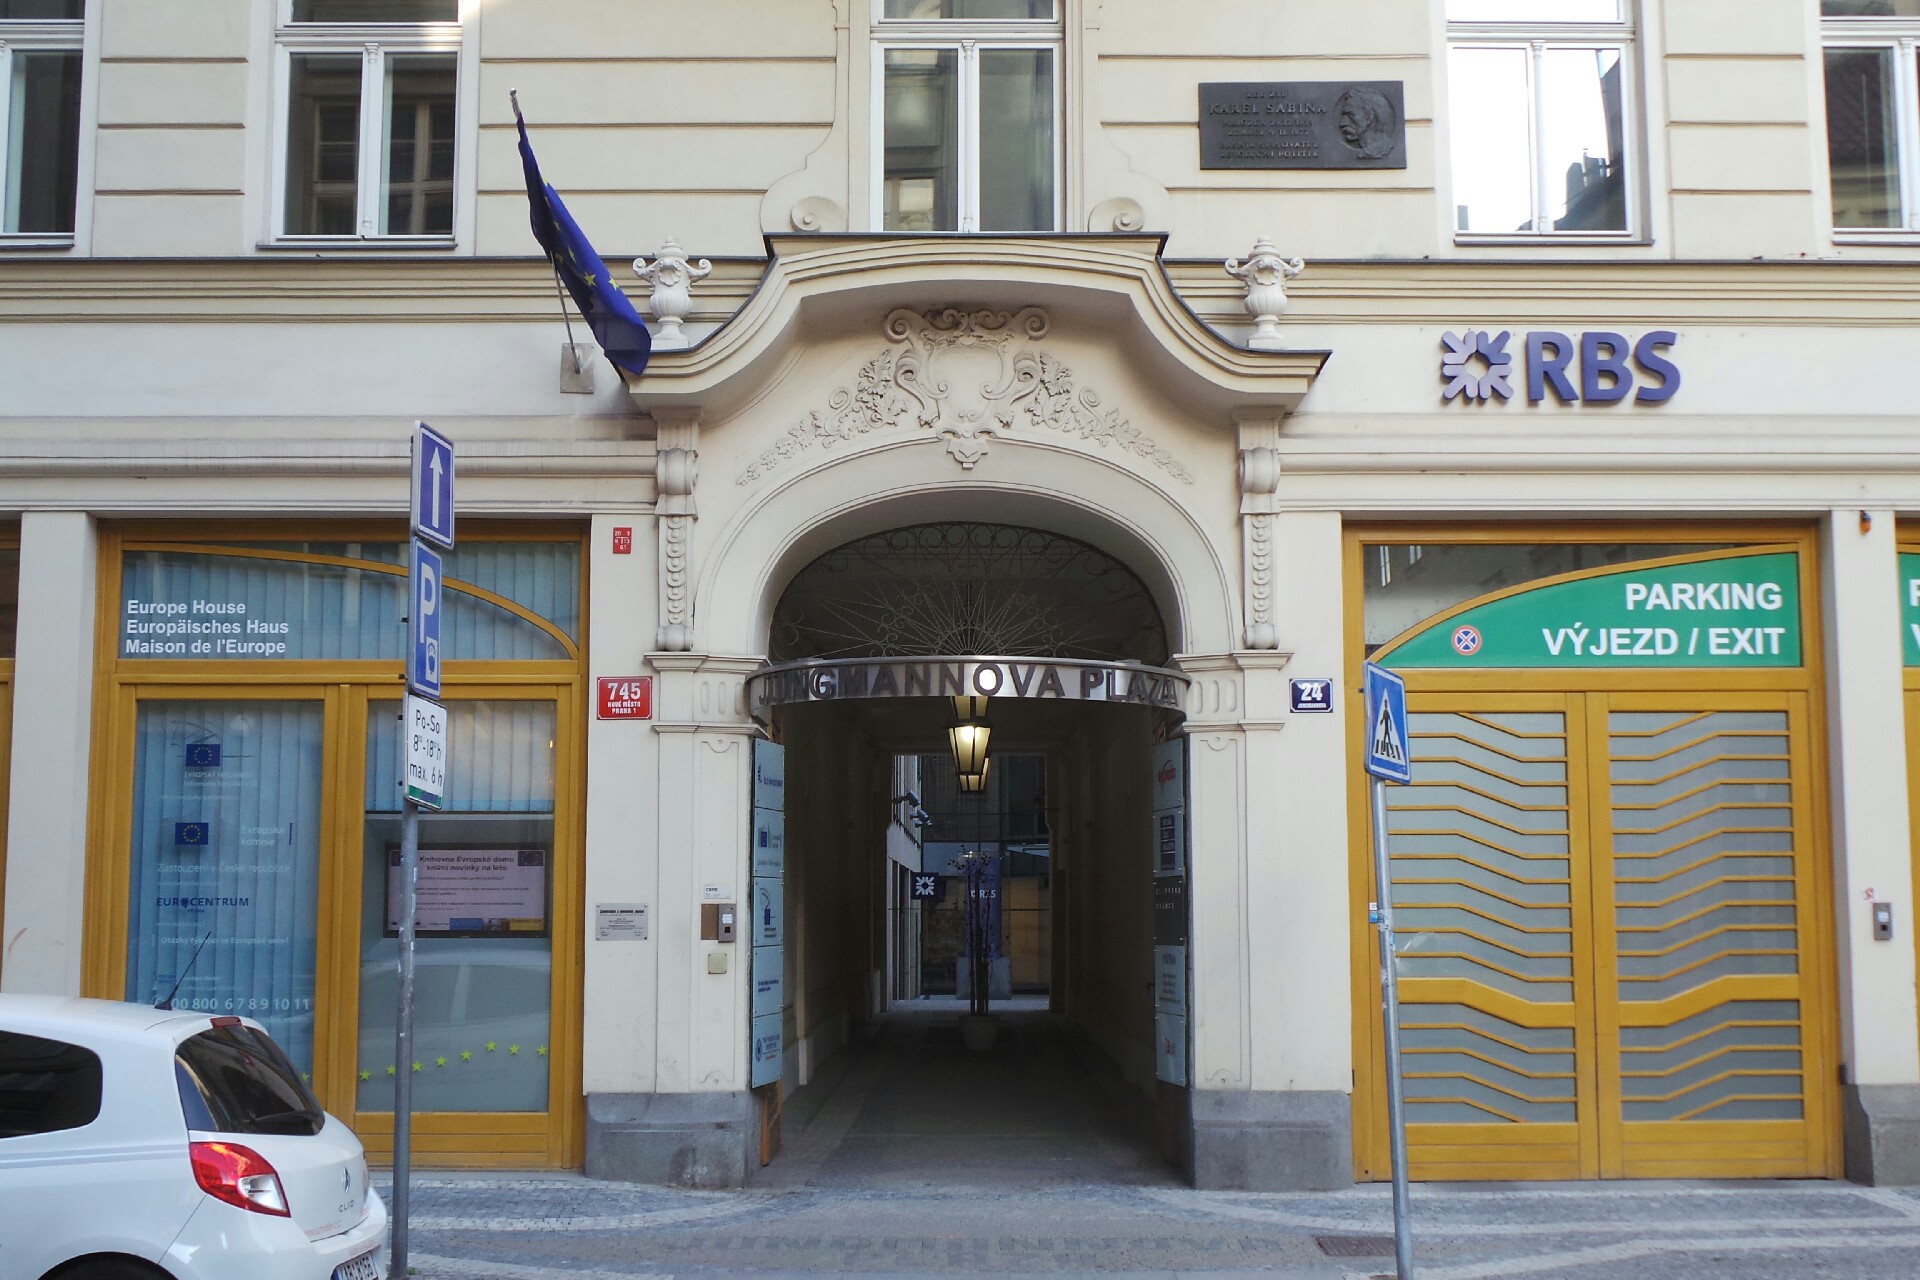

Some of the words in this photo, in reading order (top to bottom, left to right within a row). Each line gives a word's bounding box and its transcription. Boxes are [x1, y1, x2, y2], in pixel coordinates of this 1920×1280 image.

[1209, 103, 1259, 115] KAREL
[1266, 103, 1327, 114] SABINA
[1278, 150, 1319, 158] POLITIK
[1526, 330, 1681, 402] RBS
[420, 562, 436, 644] P
[1625, 583, 1783, 610] PARKING
[127, 600, 188, 617] Europe
[192, 600, 246, 614] House
[126, 619, 241, 636] Europäisches
[246, 619, 289, 634] Haus
[1542, 622, 1679, 655] VÝJEZD
[1688, 628, 1698, 655] /
[1709, 628, 1786, 655] EXIT
[125, 639, 186, 654] Maison
[191, 639, 212, 654] de
[216, 639, 286, 656] l'Europe
[607, 682, 641, 700] 745
[758, 663, 1066, 705] JUNGMANNOVA
[1080, 668, 1179, 707] PLAZA
[1301, 682, 1323, 701] 24
[607, 700, 621, 708] NOVÉ
[622, 700, 641, 708] MĚSTO
[415, 709, 441, 734] Po-So
[409, 763, 428, 782] max.
[431, 766, 436, 784] 6
[438, 769, 443, 787] h
[450, 864, 479, 872] novinky
[156, 897, 249, 907] EUROCENTRUM
[192, 998, 218, 1010] 800
[224, 998, 233, 1010] 6
[236, 998, 245, 1010] 7
[249, 998, 257, 1010] 8
[260, 998, 268, 1010] 9
[274, 998, 290, 1010] 10
[294, 998, 309, 1010] 11
[338, 1200, 354, 1213] CLIO
